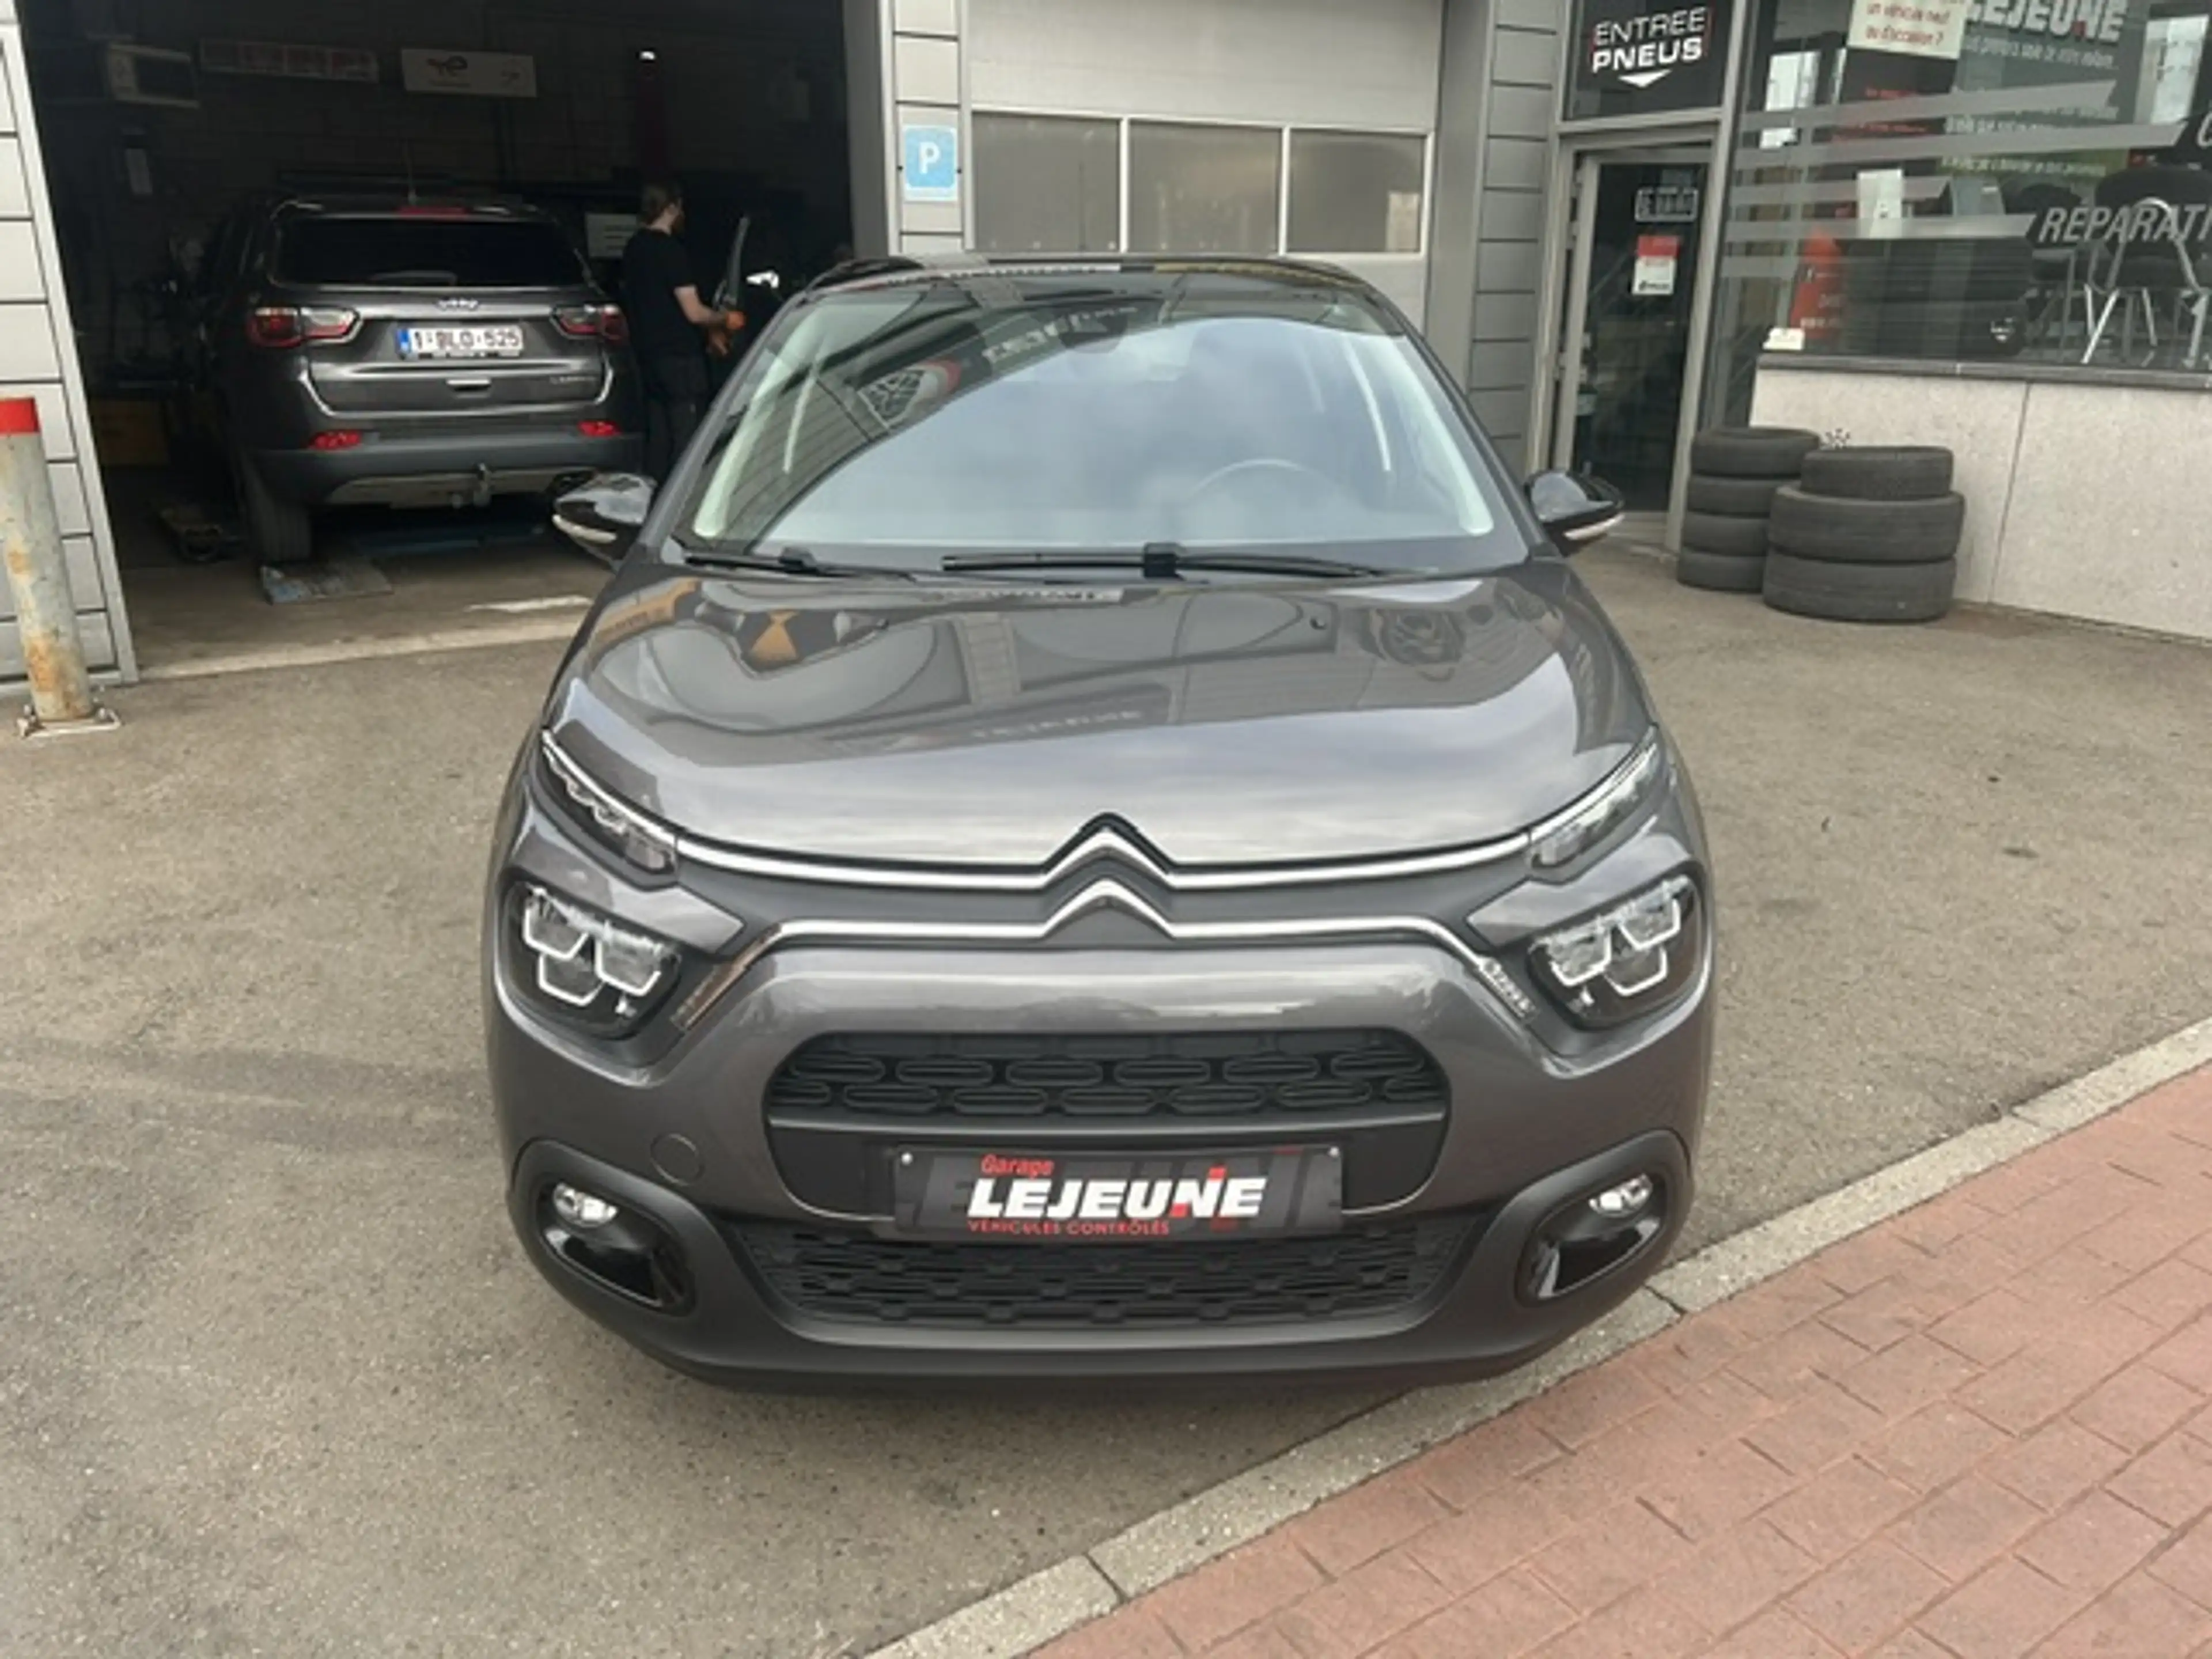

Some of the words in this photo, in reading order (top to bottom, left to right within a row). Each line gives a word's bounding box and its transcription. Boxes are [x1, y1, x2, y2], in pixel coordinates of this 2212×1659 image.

[1592, 36, 1703, 73] PNEUS
[919, 142, 942, 175] P
[980, 1153, 1054, 1181] Garage
[967, 1168, 1267, 1218] LEJEUNE
